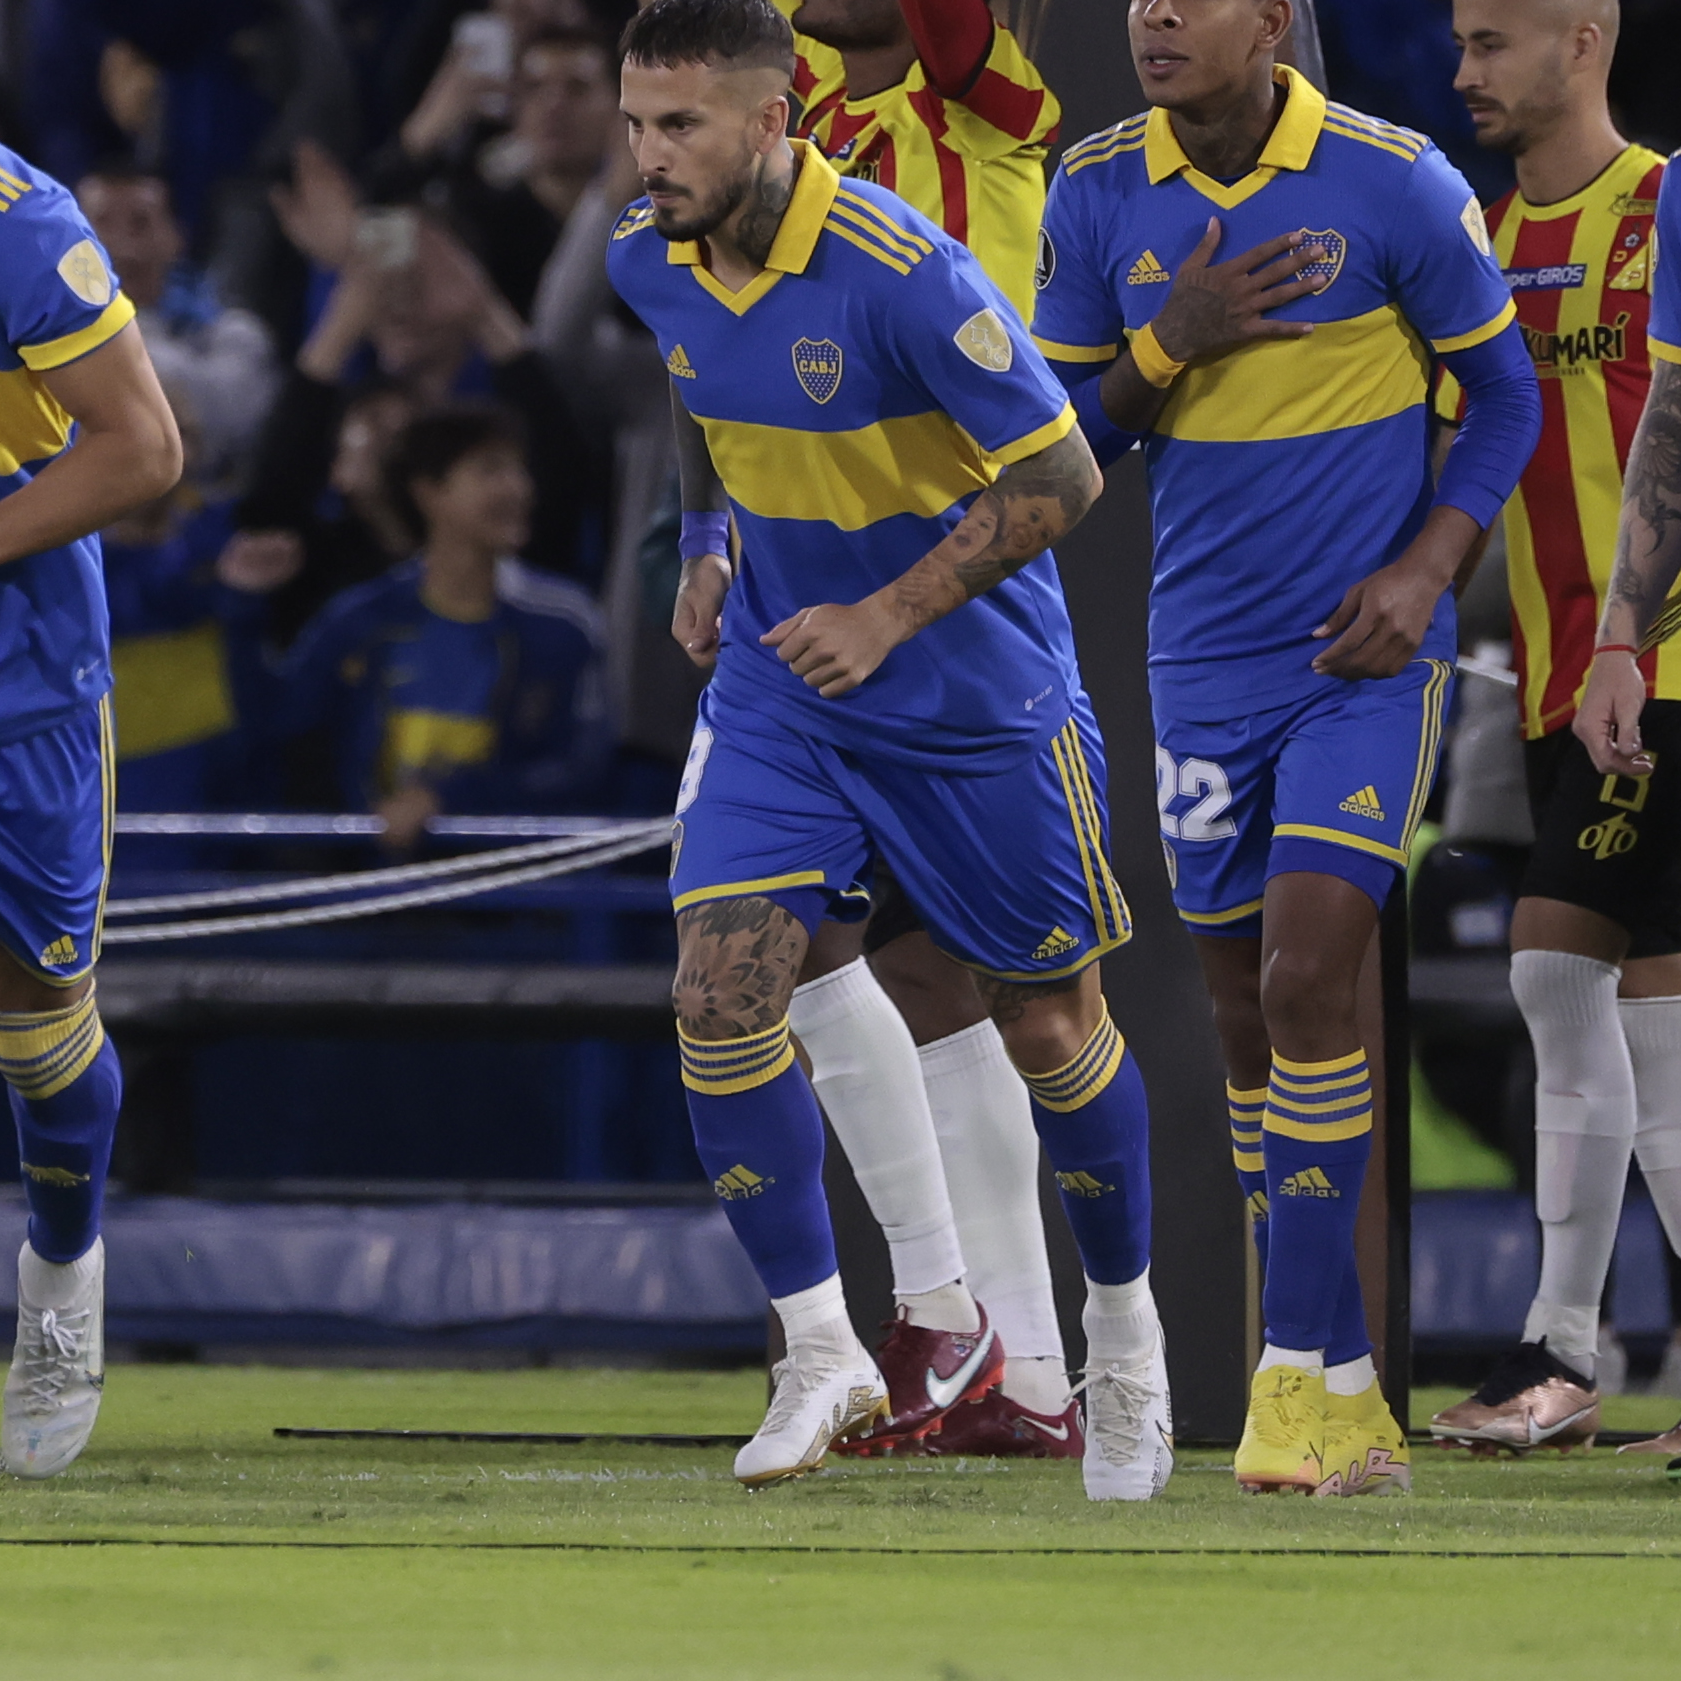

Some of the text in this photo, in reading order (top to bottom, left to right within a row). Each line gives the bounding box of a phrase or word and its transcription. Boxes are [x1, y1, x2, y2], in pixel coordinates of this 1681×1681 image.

[1126, 271, 1170, 285] adidas
[798, 360, 837, 374] CABJ
[1338, 801, 1386, 822] adidas
[1031, 936, 1080, 960] adidas
